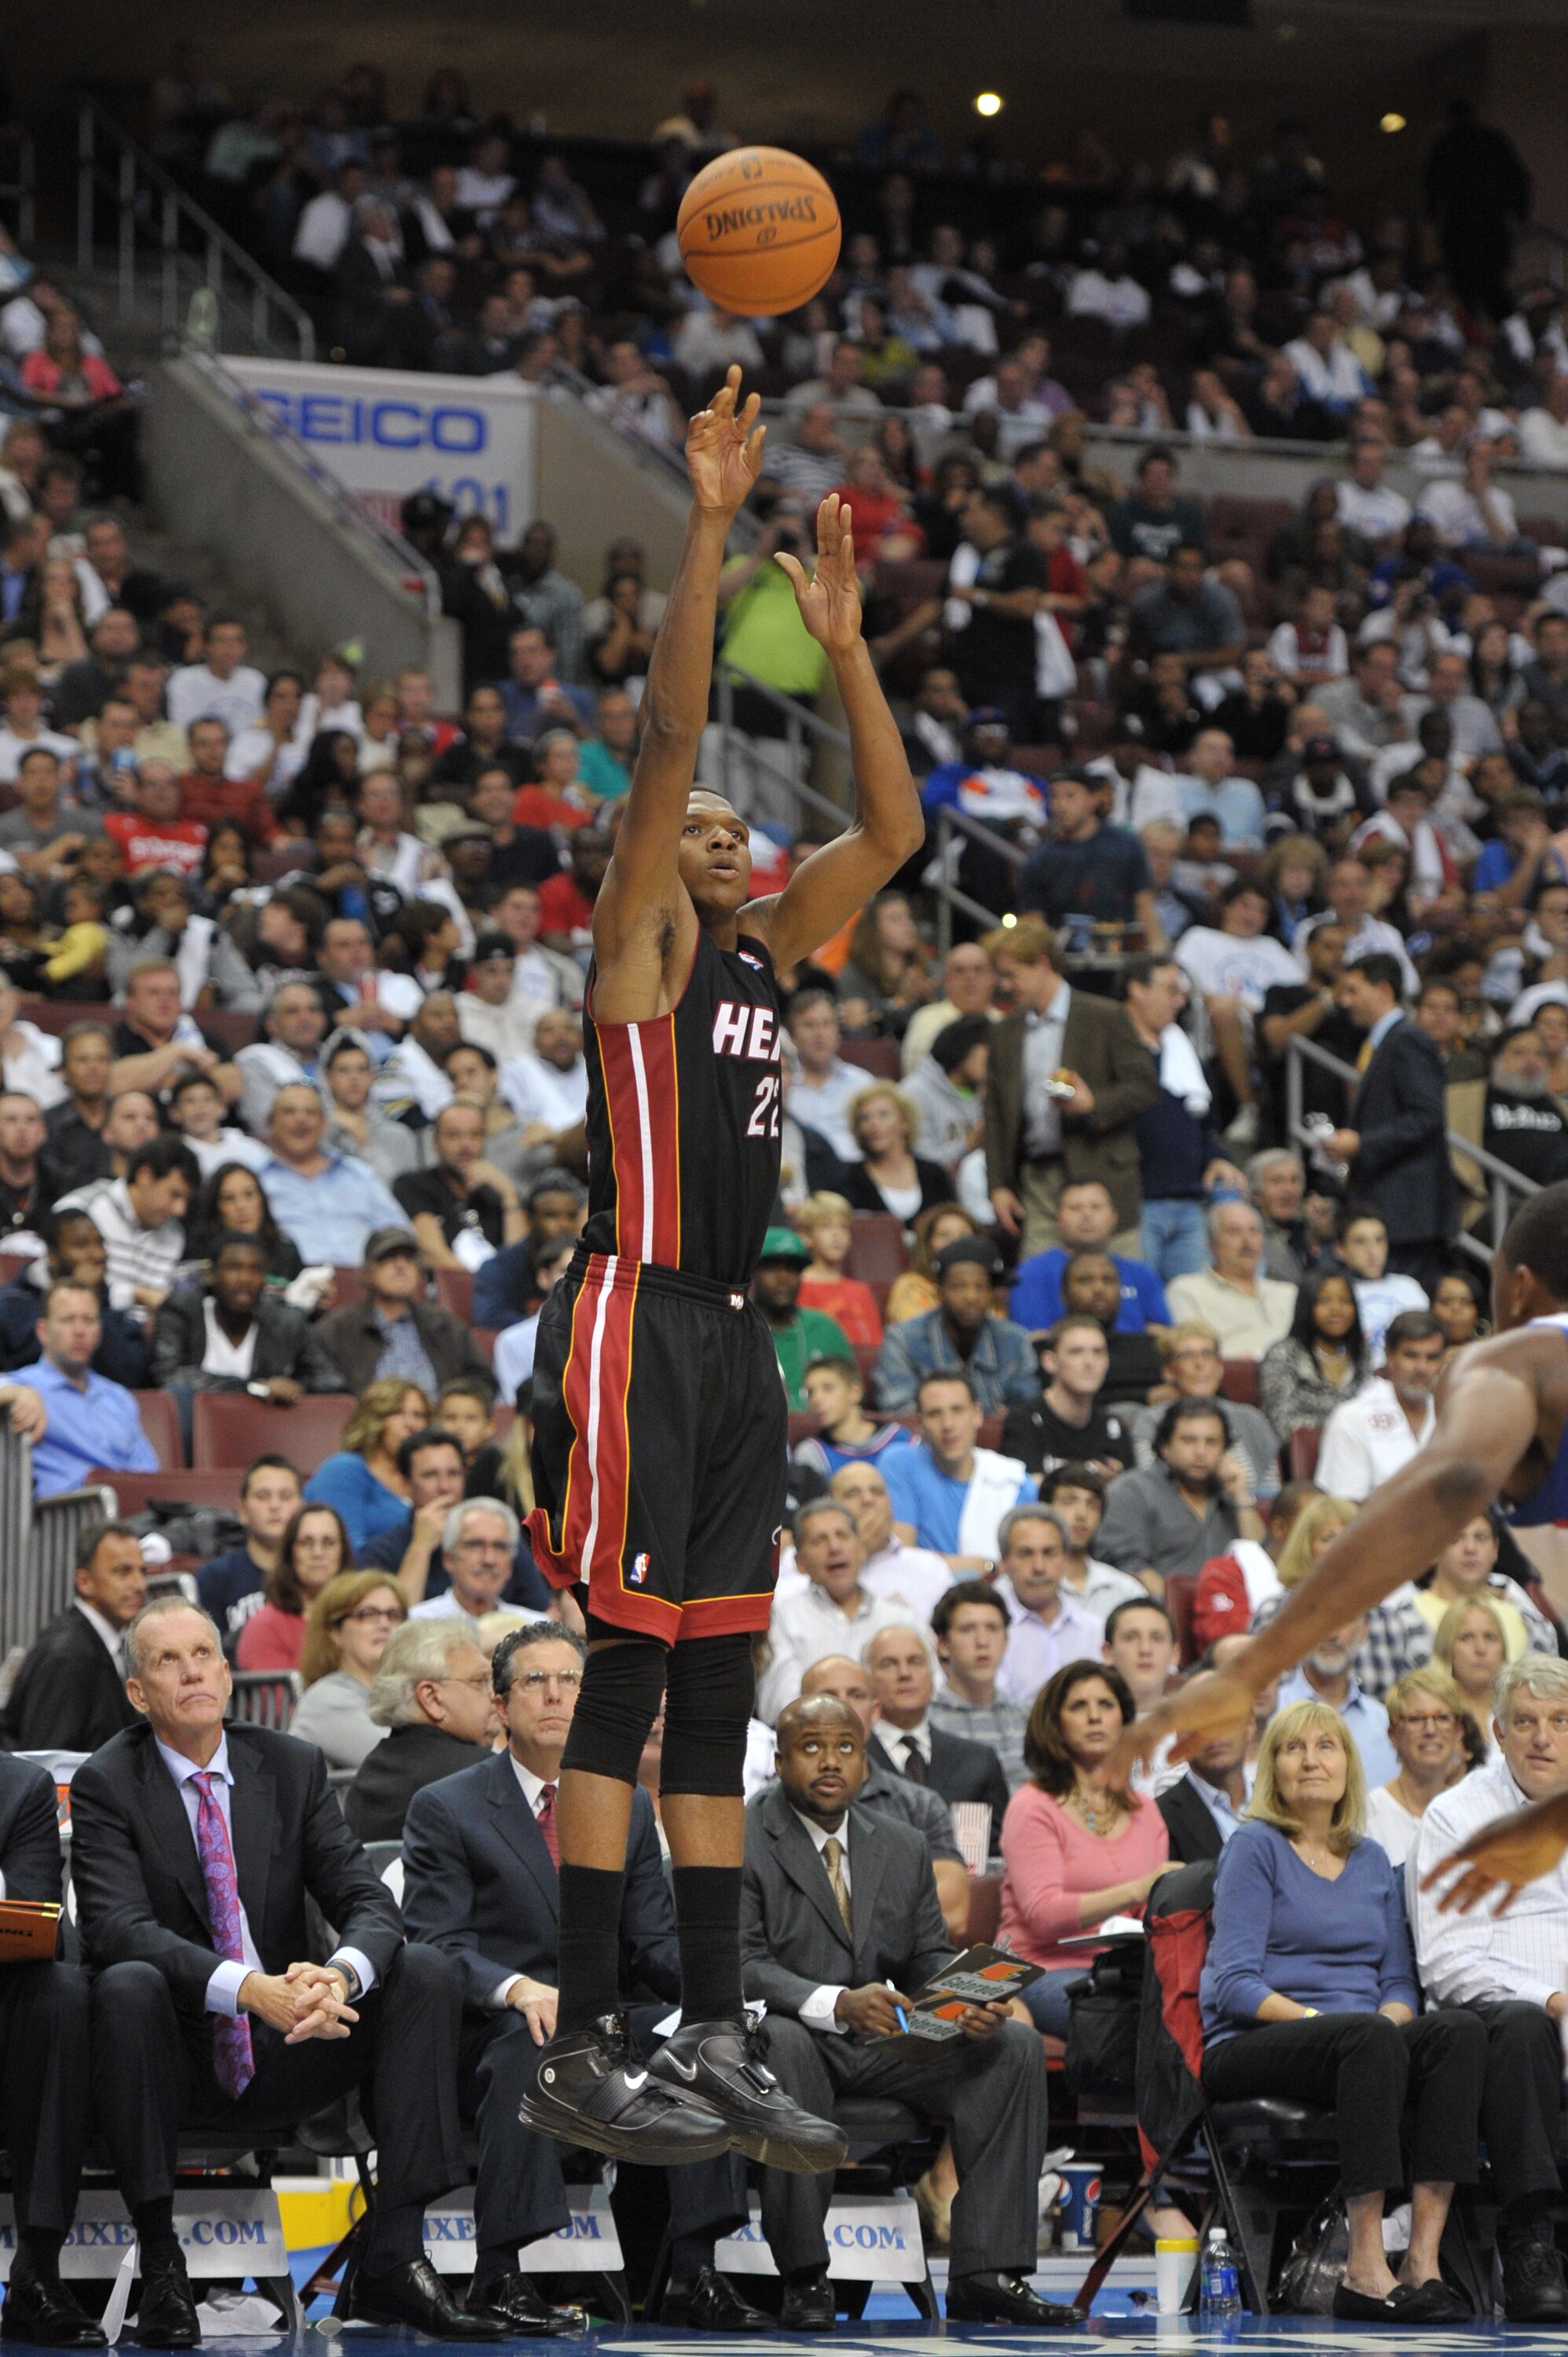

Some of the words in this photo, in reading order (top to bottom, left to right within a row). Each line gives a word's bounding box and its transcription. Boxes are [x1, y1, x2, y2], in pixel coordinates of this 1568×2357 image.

[704, 195, 817, 240] SPALDING
[256, 390, 487, 453] GEICO
[940, 1975, 1006, 1998] Gatorade
[597, 2331, 1568, 2357] SIXE
